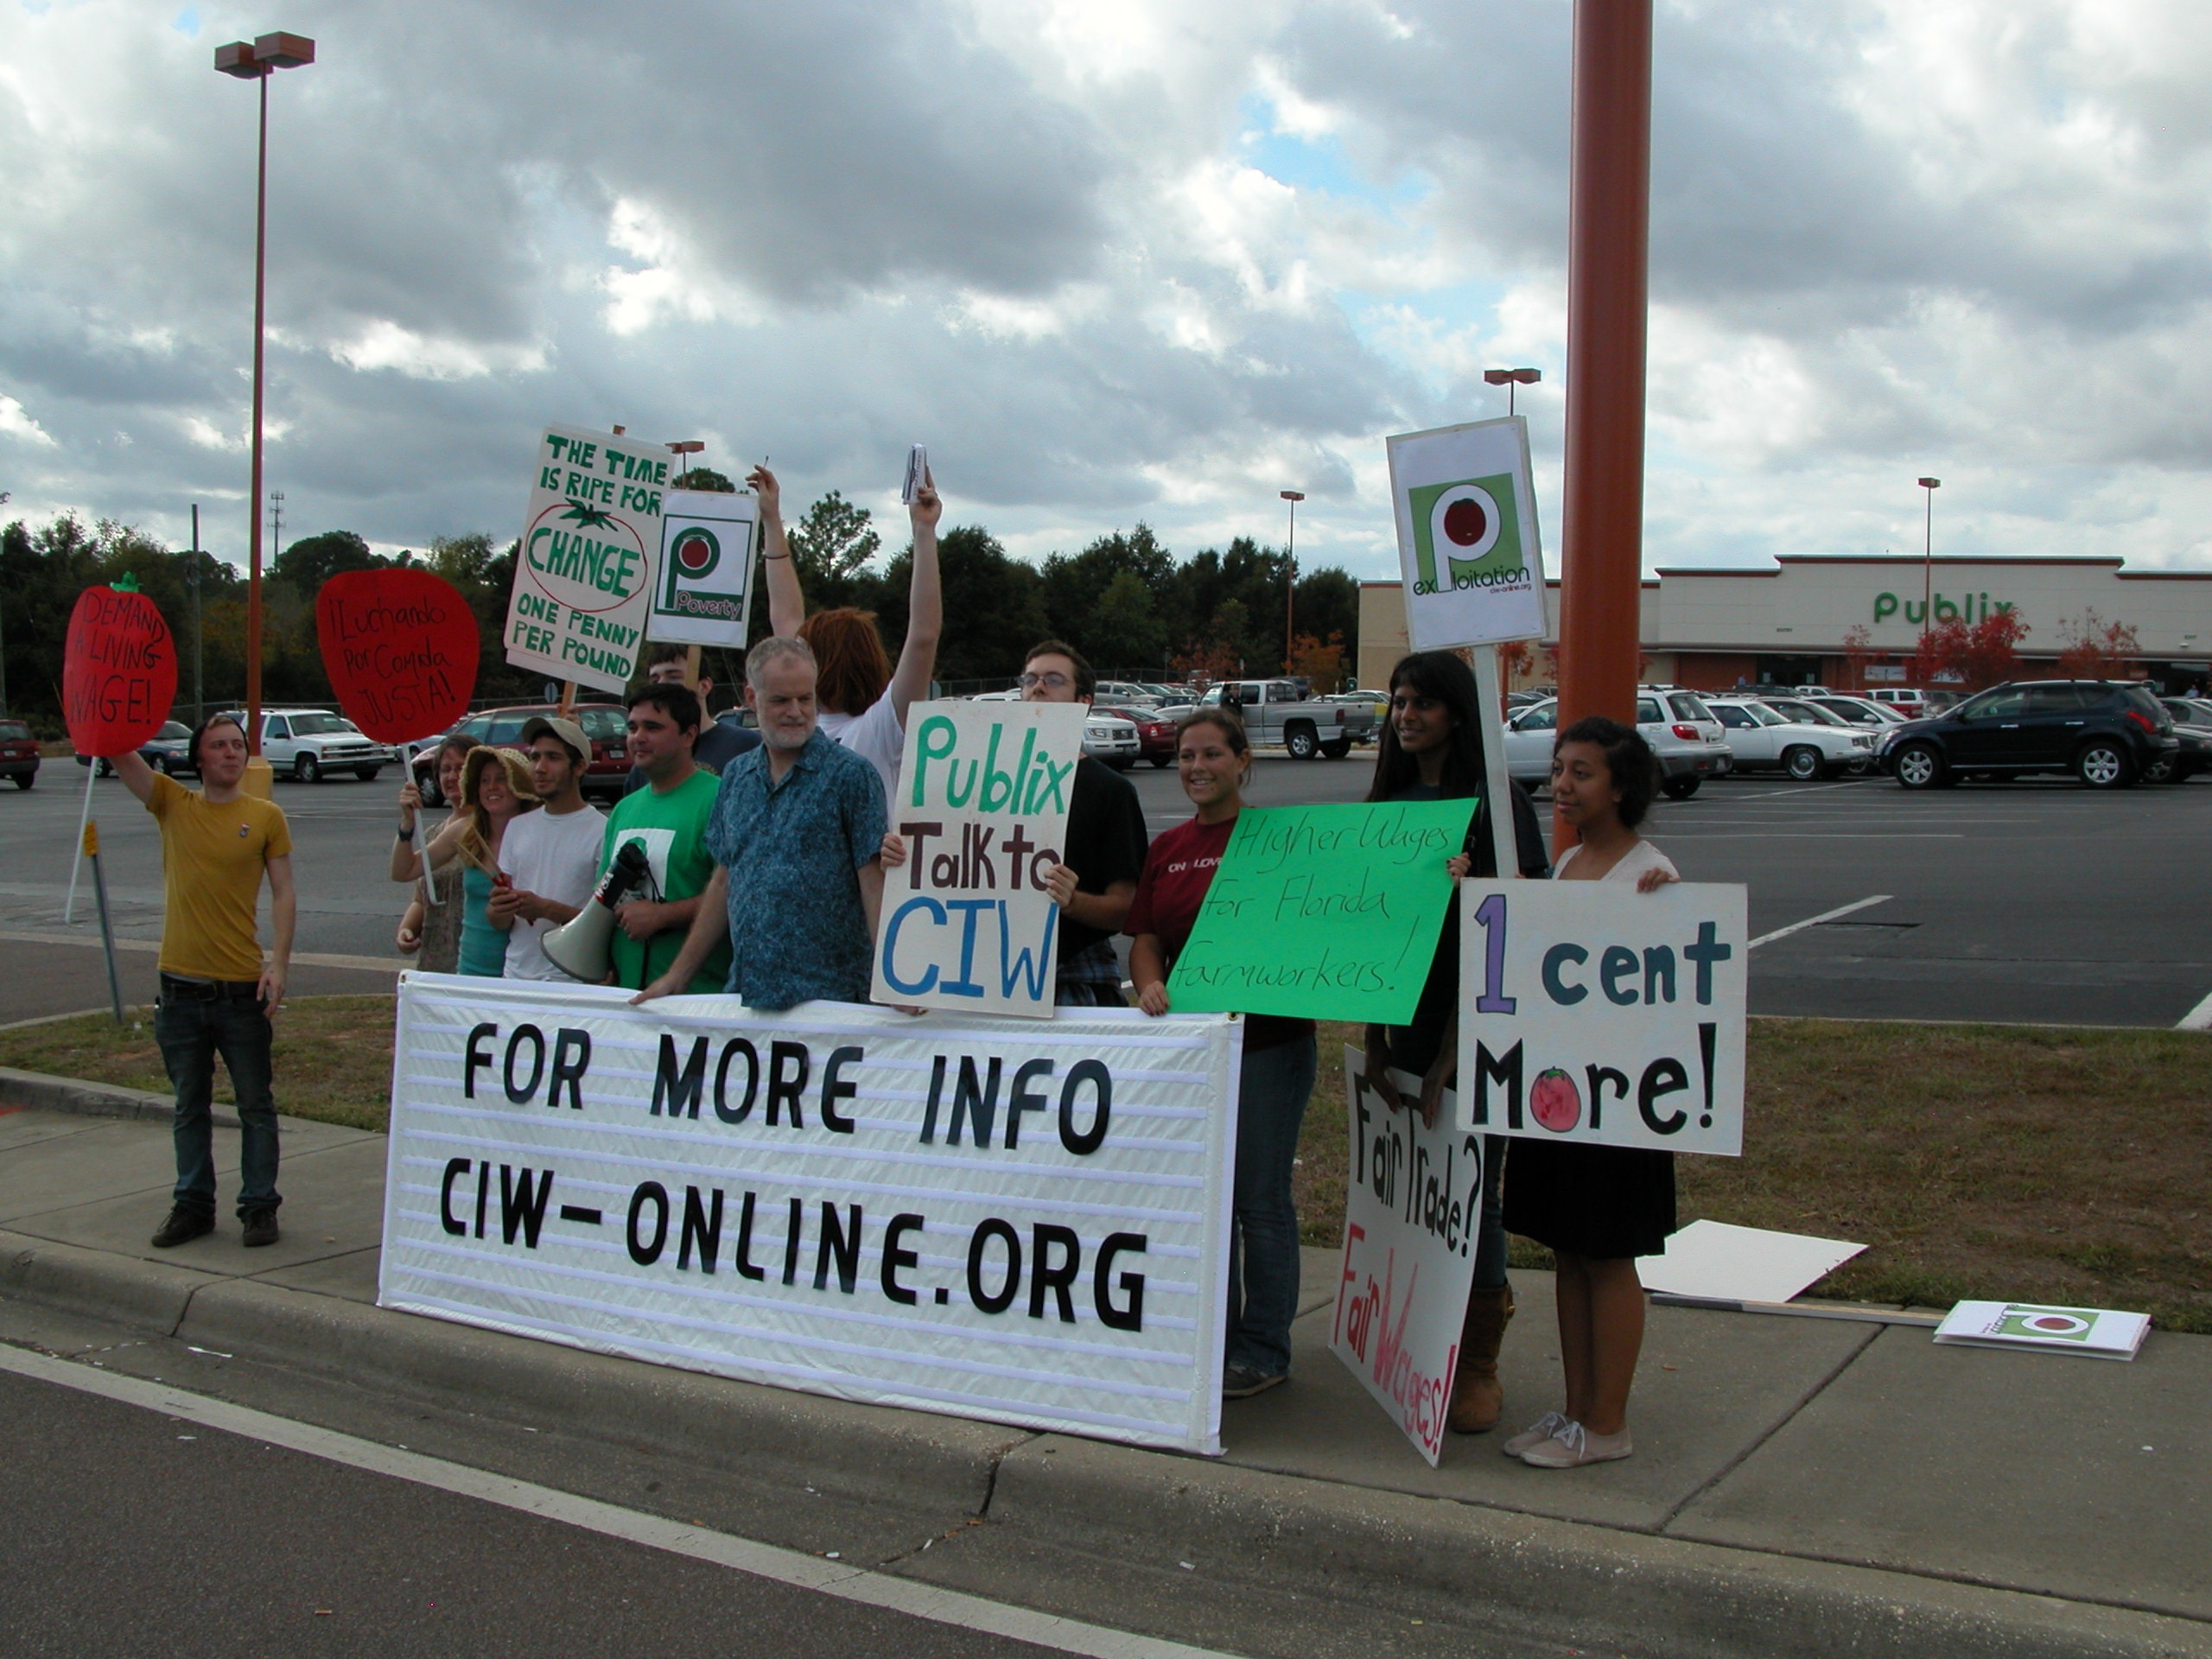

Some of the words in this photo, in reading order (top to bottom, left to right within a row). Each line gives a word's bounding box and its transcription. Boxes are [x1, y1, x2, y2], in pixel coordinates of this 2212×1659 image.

[546, 434, 598, 469] THE
[605, 448, 667, 486] TIME
[540, 466, 559, 492] IS
[565, 472, 615, 505] RIPE
[620, 484, 663, 518] FOR
[528, 526, 640, 598] CHANGE
[83, 592, 165, 644] DEMAND
[516, 592, 559, 624] ONE
[567, 609, 639, 650] PENNY
[677, 590, 741, 620] Poverty
[1873, 591, 2013, 625] Publix
[74, 626, 85, 655] A
[89, 628, 162, 671] LIVING
[512, 620, 556, 655] PER
[561, 636, 632, 678] POUND
[70, 672, 152, 726] WAGE!
[356, 670, 457, 727] JUSTA!
[911, 715, 1074, 816] Publix
[899, 822, 996, 890] Talk
[1001, 823, 1064, 892] to
[1167, 861, 1187, 874] ON
[1234, 810, 1357, 874] Higher
[1358, 806, 1451, 865] Wages
[1274, 866, 1390, 922] Florida
[881, 896, 1058, 1002] CIW
[1474, 893, 1517, 1016] 1
[1541, 921, 1732, 1006] cent
[464, 1022, 593, 1110] FOR
[650, 1033, 865, 1135] MORE
[918, 1054, 1113, 1156] INFO
[1471, 1022, 1718, 1135] More!
[1354, 1071, 1402, 1210] Fair
[1398, 1092, 1482, 1258] Trade?
[1333, 1222, 1380, 1364] Fair
[1373, 1246, 1457, 1456] Wages!
